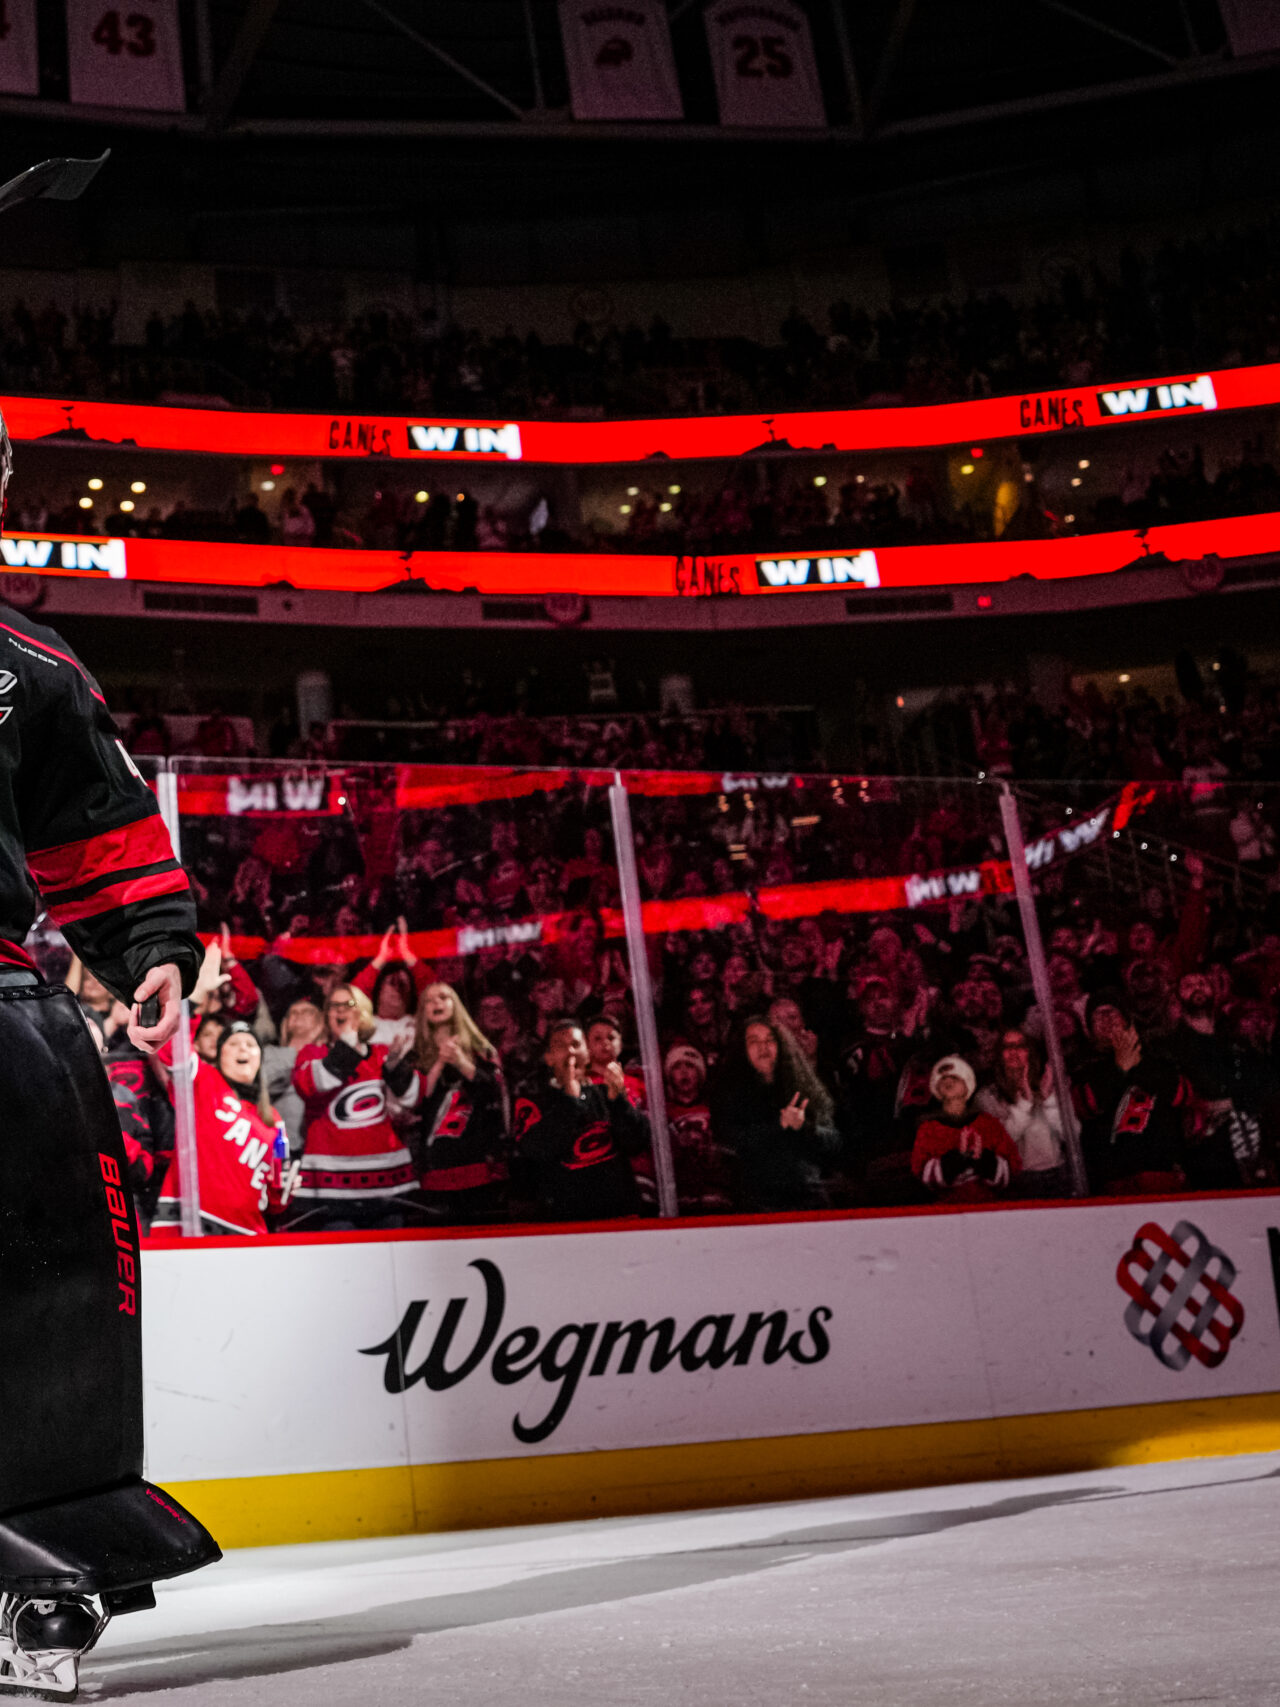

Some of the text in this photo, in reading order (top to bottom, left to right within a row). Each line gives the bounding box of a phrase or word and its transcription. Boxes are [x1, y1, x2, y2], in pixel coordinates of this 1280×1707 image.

[93, 10, 155, 56] 43
[733, 36, 793, 77] 25
[1020, 375, 1218, 428] CANES WIN
[328, 420, 522, 460] CANES WIN
[0, 538, 127, 579] WIN
[760, 551, 880, 588] WIN
[357, 1258, 833, 1444] Wegmans
